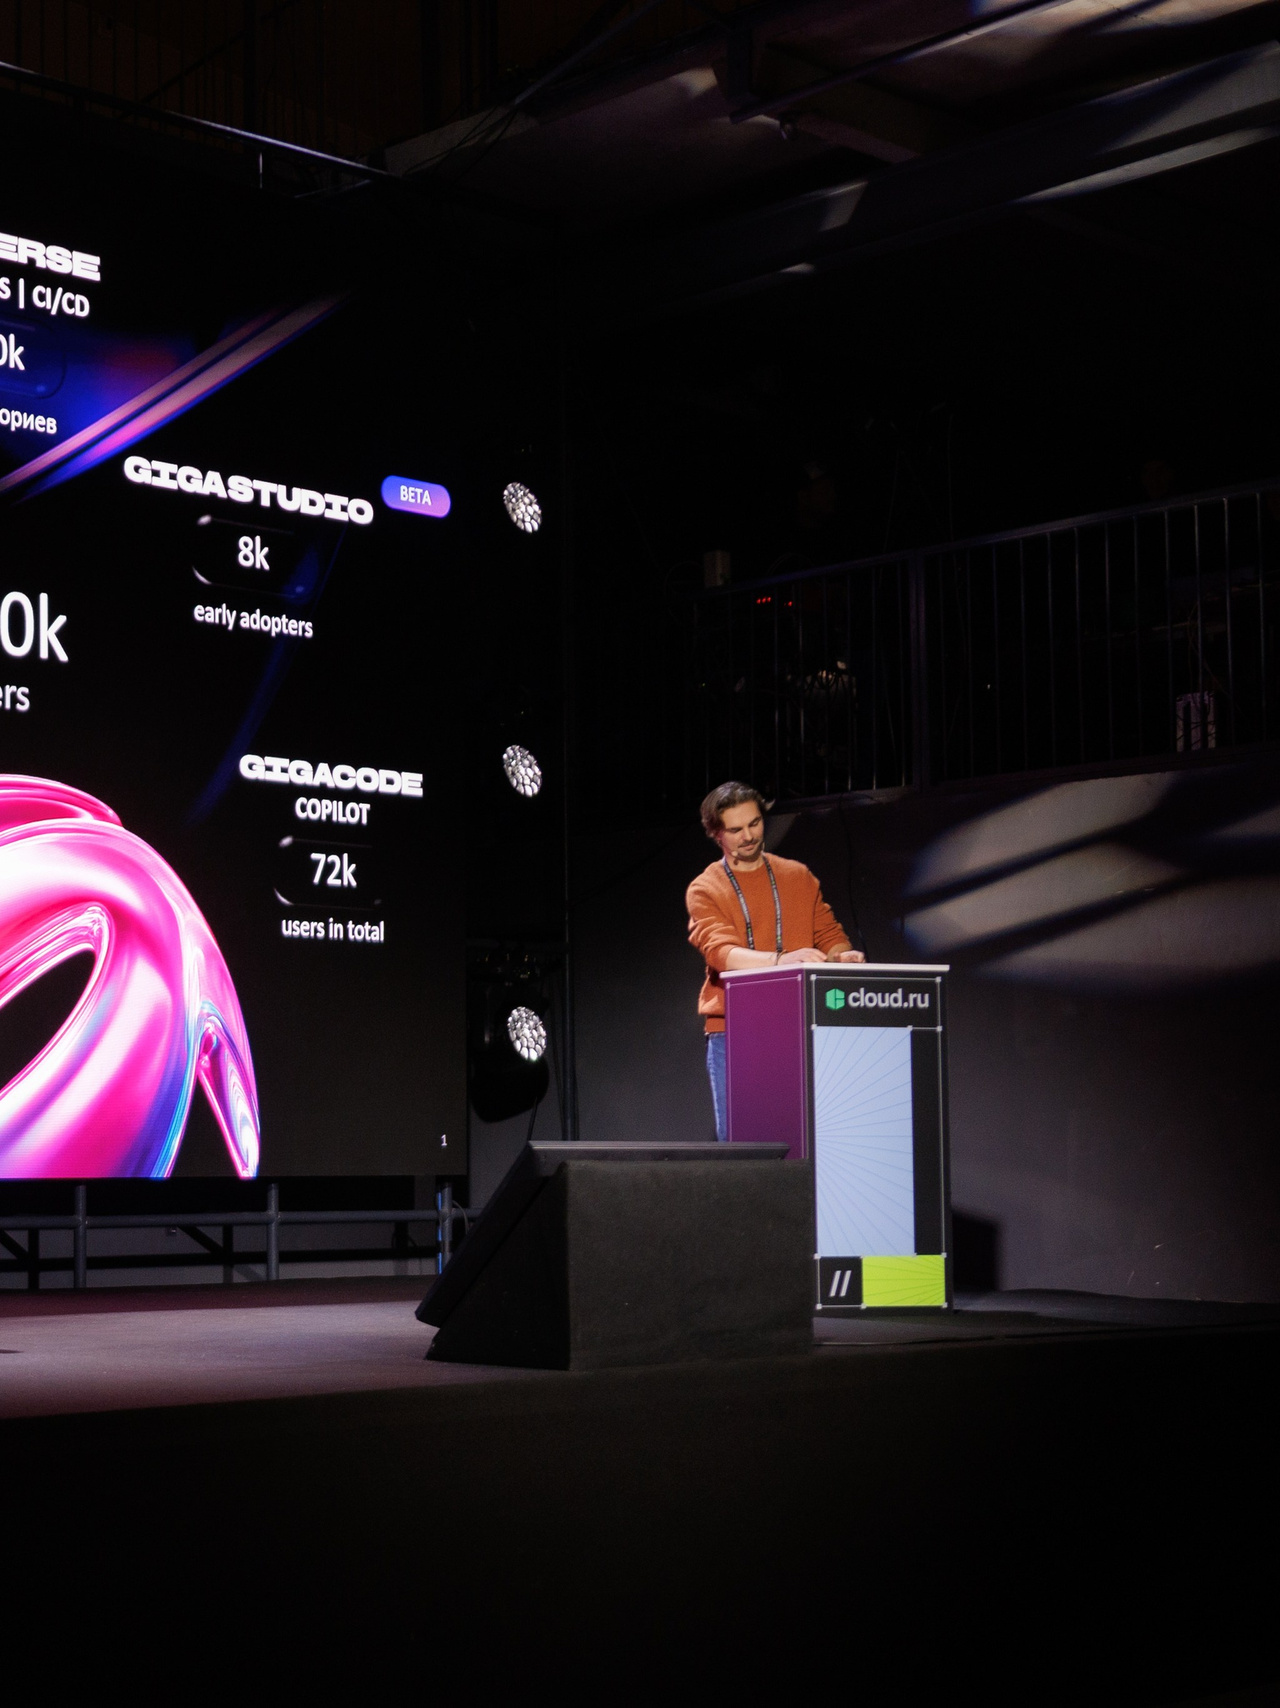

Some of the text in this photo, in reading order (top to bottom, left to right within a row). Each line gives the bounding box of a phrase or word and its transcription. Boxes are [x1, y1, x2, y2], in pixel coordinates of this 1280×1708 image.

[32, 284, 90, 318] CI/CD
[123, 455, 374, 525] GIGASTUDIO
[399, 484, 433, 508] BETA
[237, 535, 270, 571] 8k
[193, 602, 314, 638] early adopters
[238, 754, 423, 797] GIGACODE
[294, 797, 370, 825] COPILOT
[310, 852, 357, 888] 72k
[281, 917, 385, 942] users in total
[847, 987, 929, 1009] cloud.ru
[440, 1133, 448, 1147] 1
